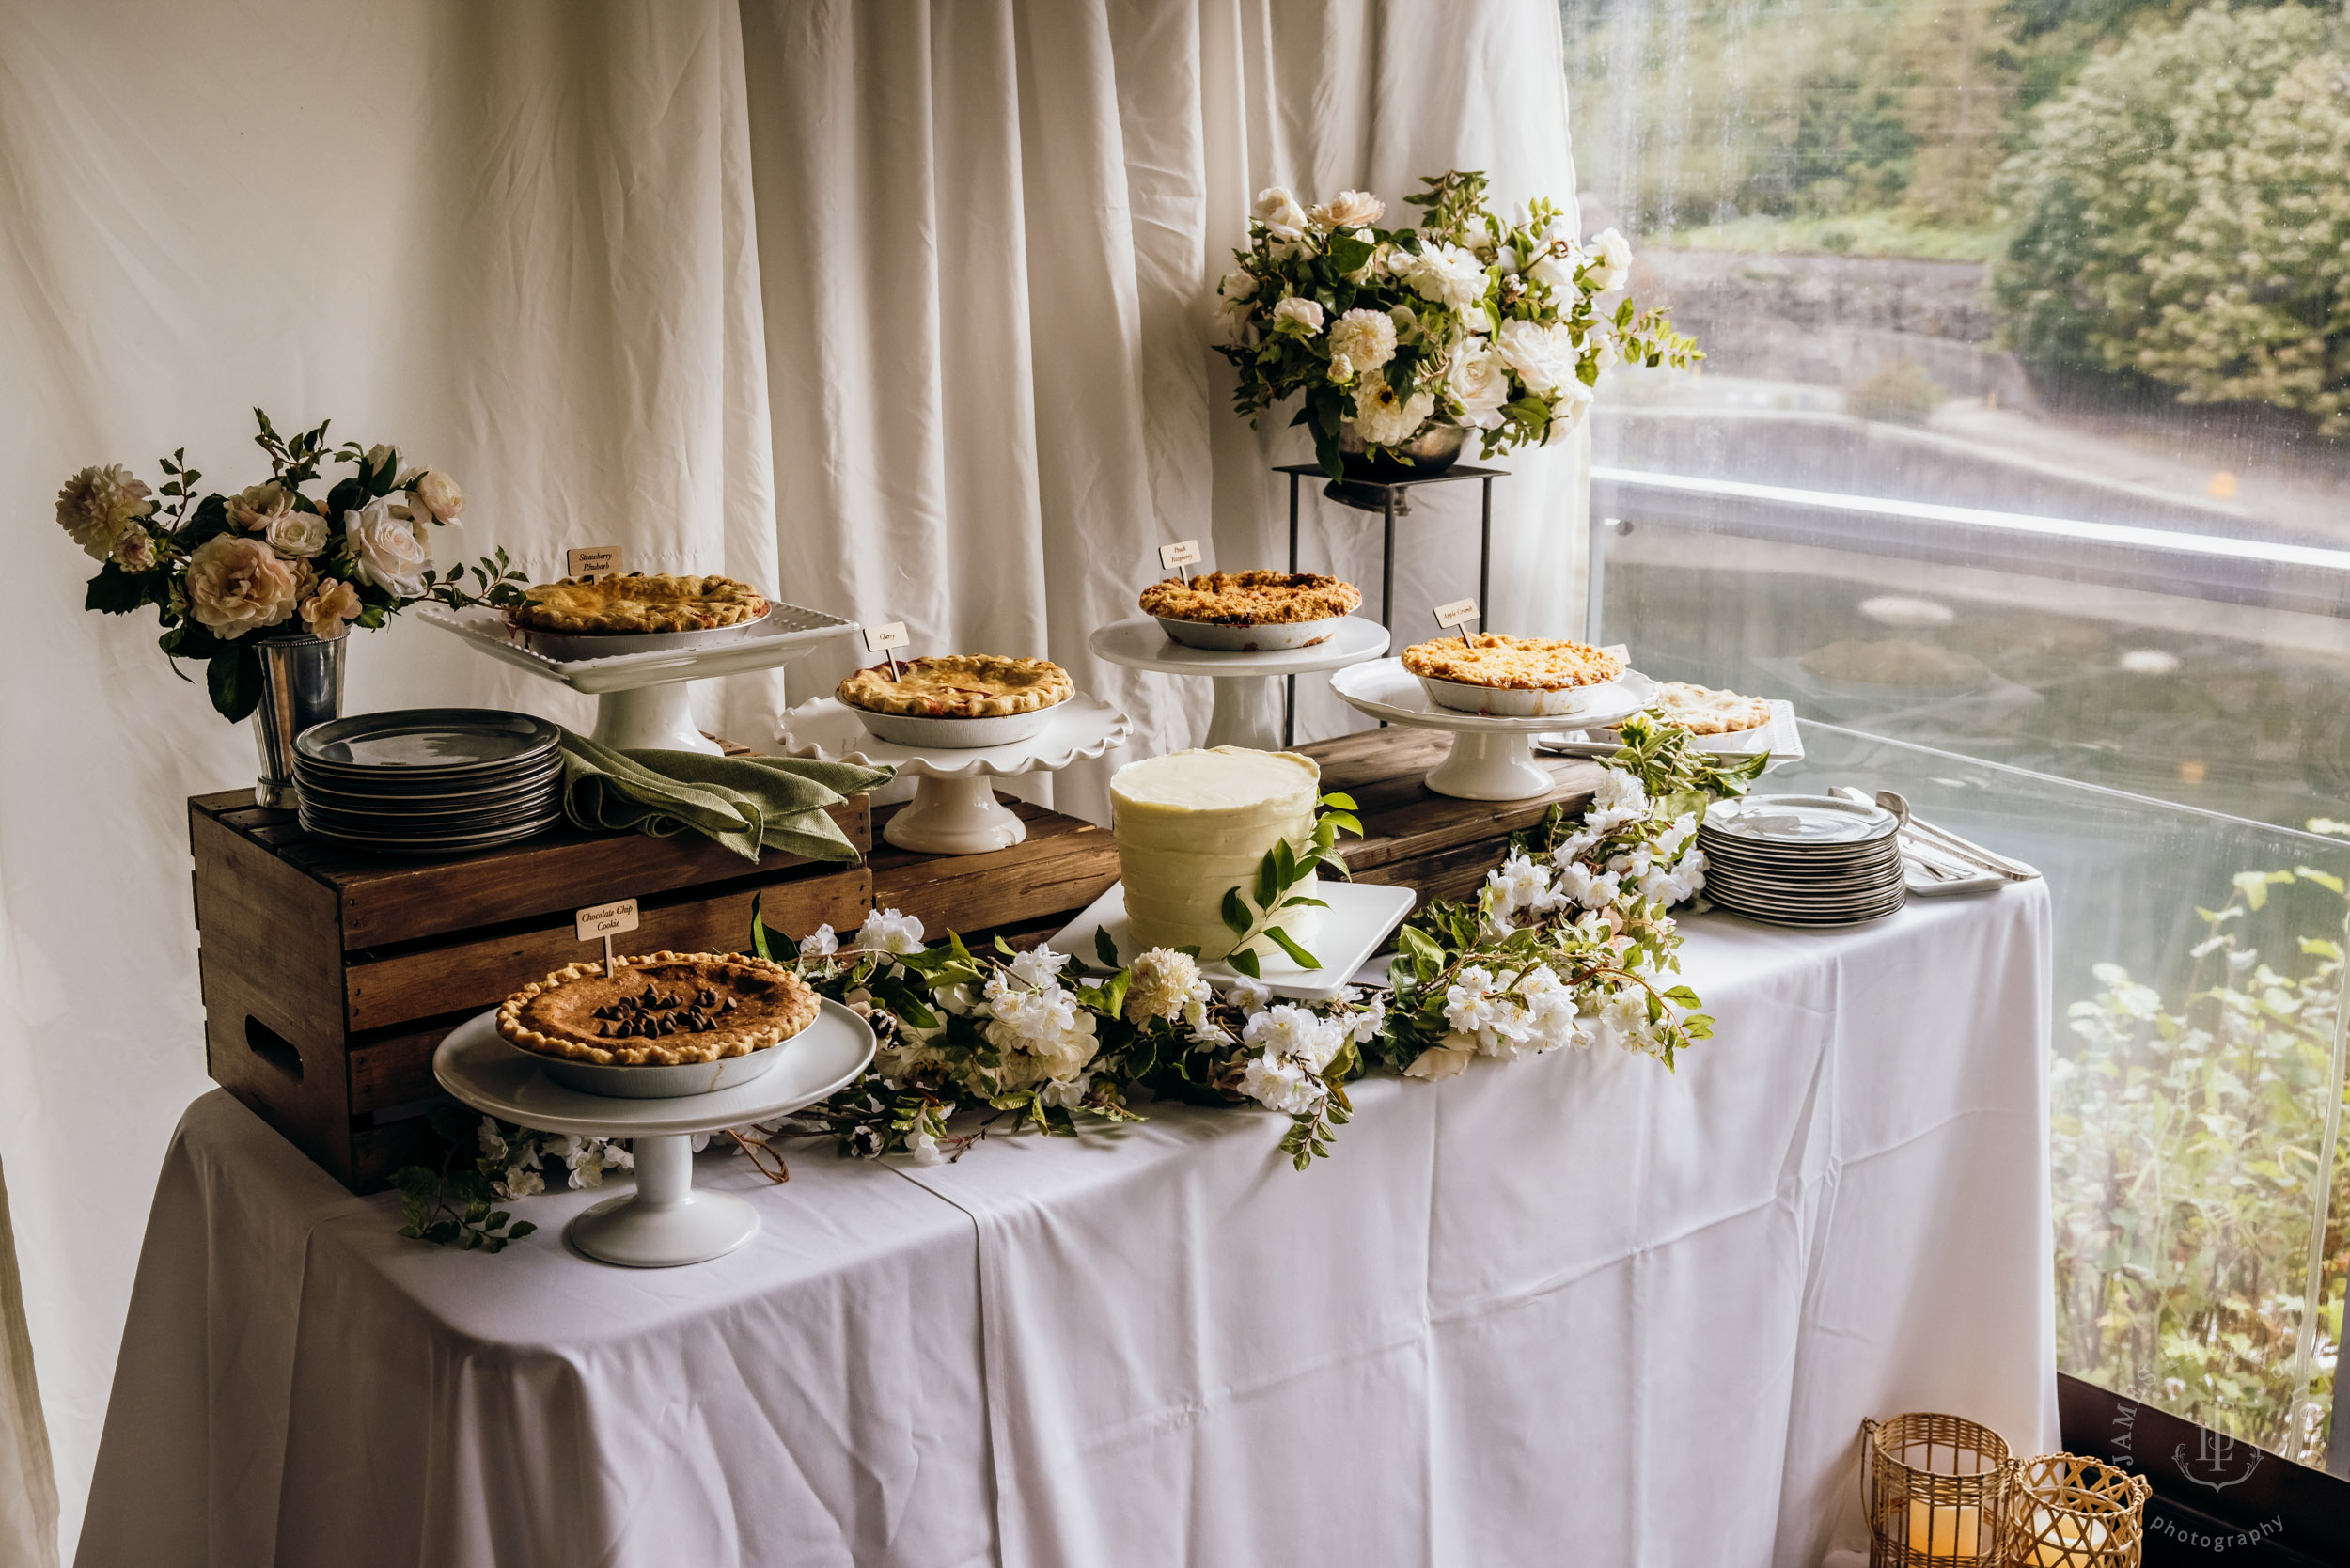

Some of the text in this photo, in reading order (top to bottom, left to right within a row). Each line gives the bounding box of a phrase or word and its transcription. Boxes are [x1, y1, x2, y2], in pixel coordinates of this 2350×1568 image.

[579, 552, 613, 561] Strawberry
[1171, 554, 1193, 563] Raspberry
[584, 561, 610, 572] Rhubarb
[1443, 605, 1473, 620] Apple Crumb
[879, 633, 896, 641] Cherry
[582, 903, 634, 923] Chocolate Chip
[597, 918, 620, 931] Cookie
